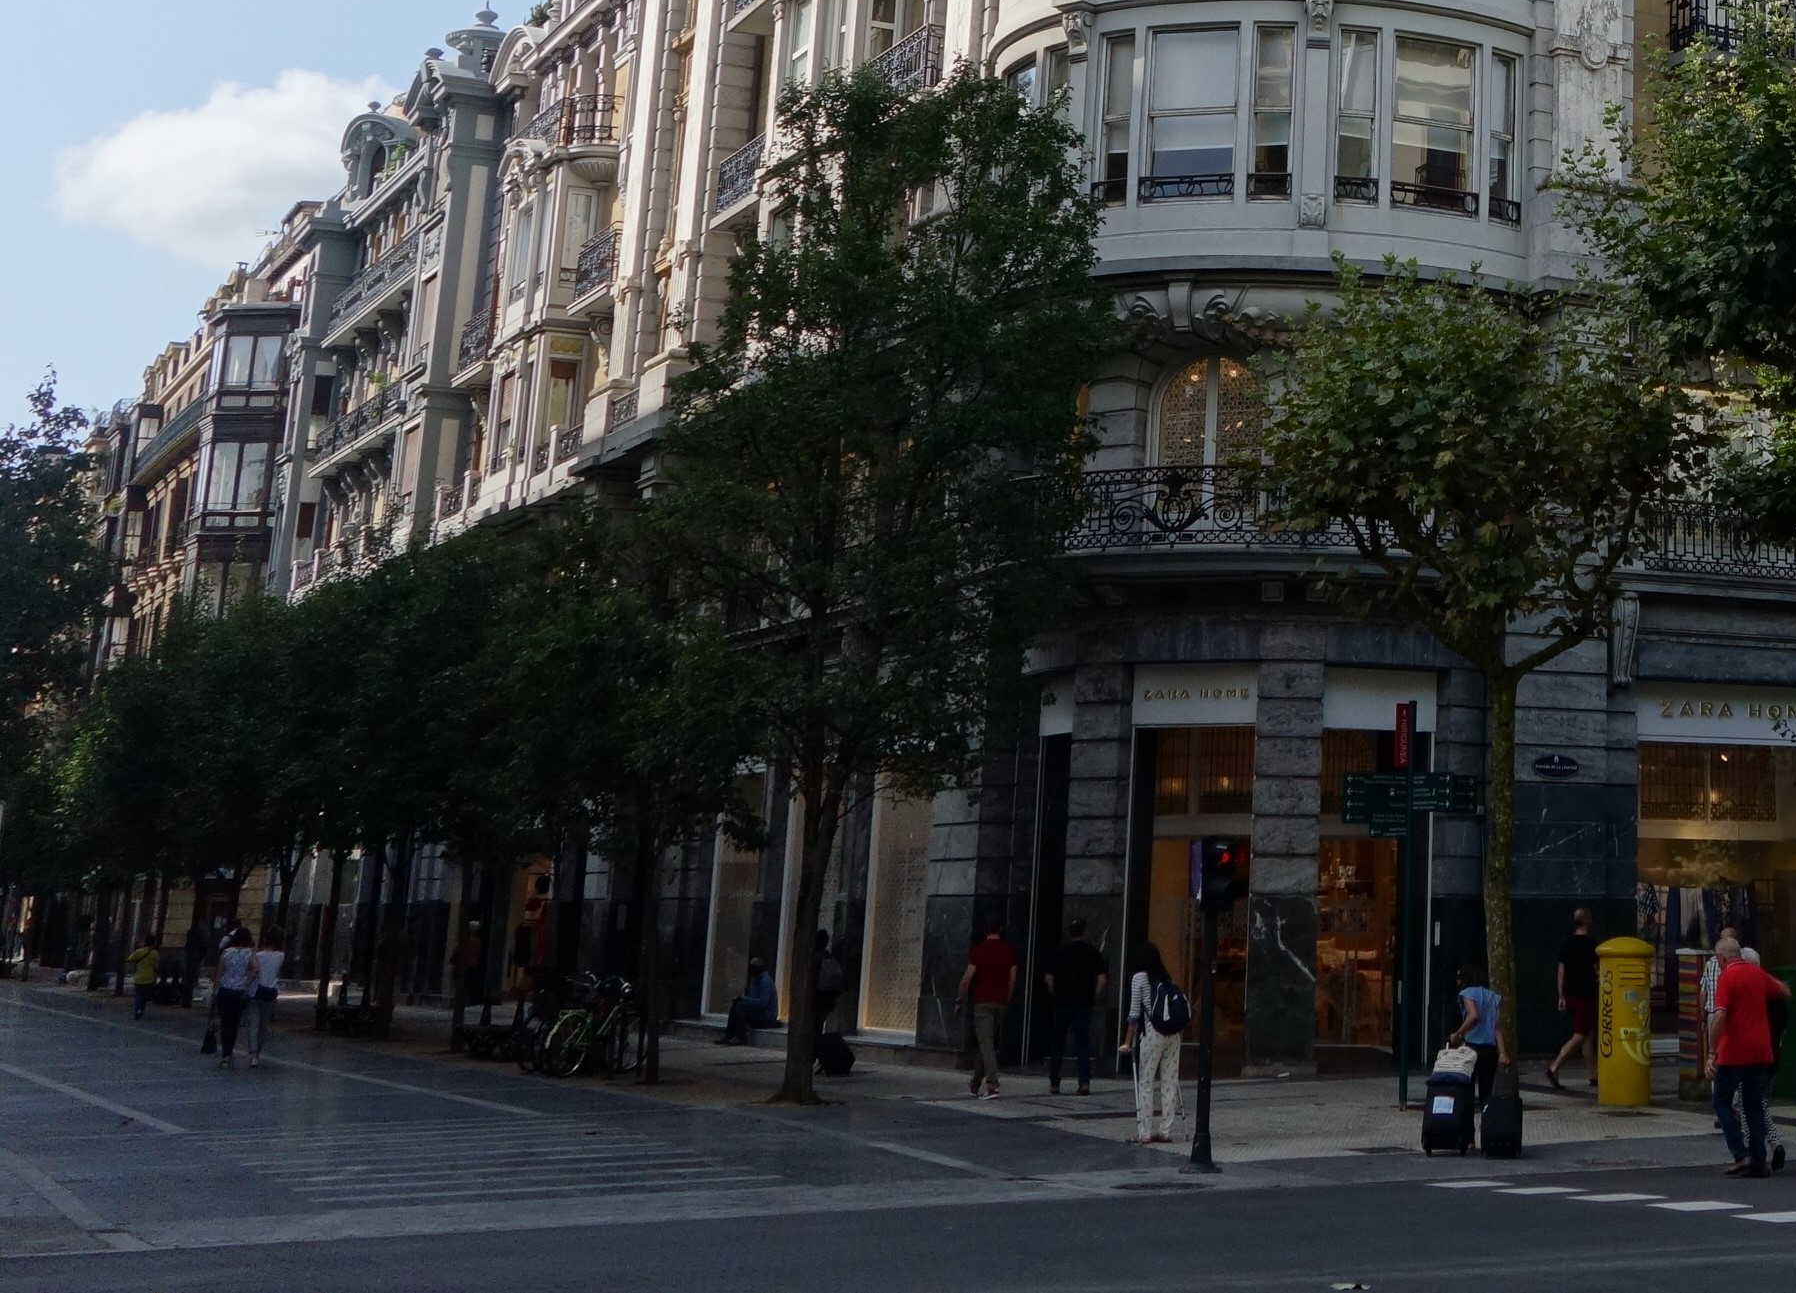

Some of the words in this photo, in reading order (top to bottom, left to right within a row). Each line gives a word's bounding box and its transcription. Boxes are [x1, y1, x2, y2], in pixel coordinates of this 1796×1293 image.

[1144, 689, 1191, 700] ZARA
[1200, 688, 1250, 700] HOME
[1660, 700, 1734, 718] ZARA
[1599, 970, 1614, 1059] CORREOS
